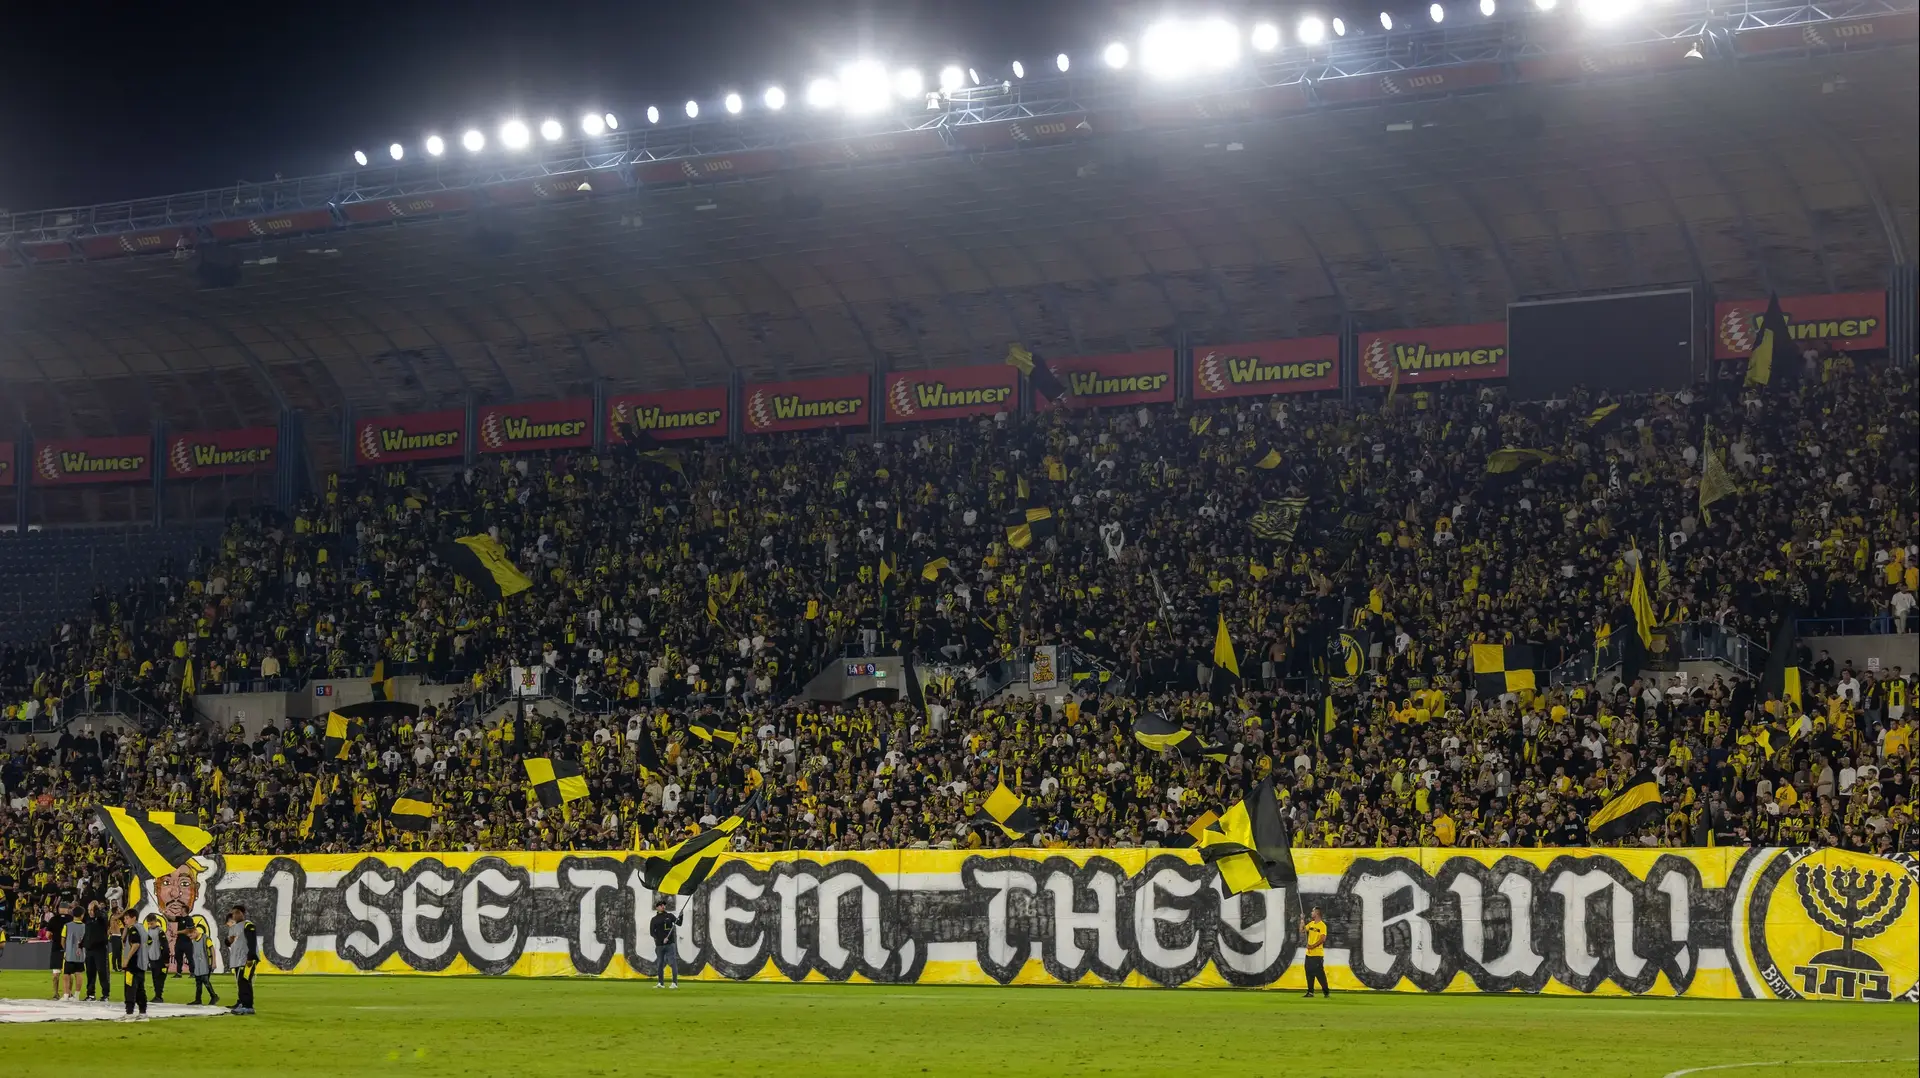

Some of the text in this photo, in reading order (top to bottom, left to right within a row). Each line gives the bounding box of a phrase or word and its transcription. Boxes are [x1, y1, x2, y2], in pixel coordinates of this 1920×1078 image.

[1396, 345, 1504, 371] Winner
[1070, 371, 1168, 396] Winner
[1229, 358, 1332, 384] Winner
[774, 395, 862, 420] Winner
[917, 383, 1010, 408] Winner
[505, 417, 586, 440] Winner
[636, 407, 721, 431] Winner
[382, 429, 459, 451] Winner
[62, 452, 144, 472] Winner
[317, 687, 324, 695] 13
[345, 868, 519, 961] SEE
[1350, 869, 1690, 979] RUN!
[1793, 965, 1893, 1001] ביתר
